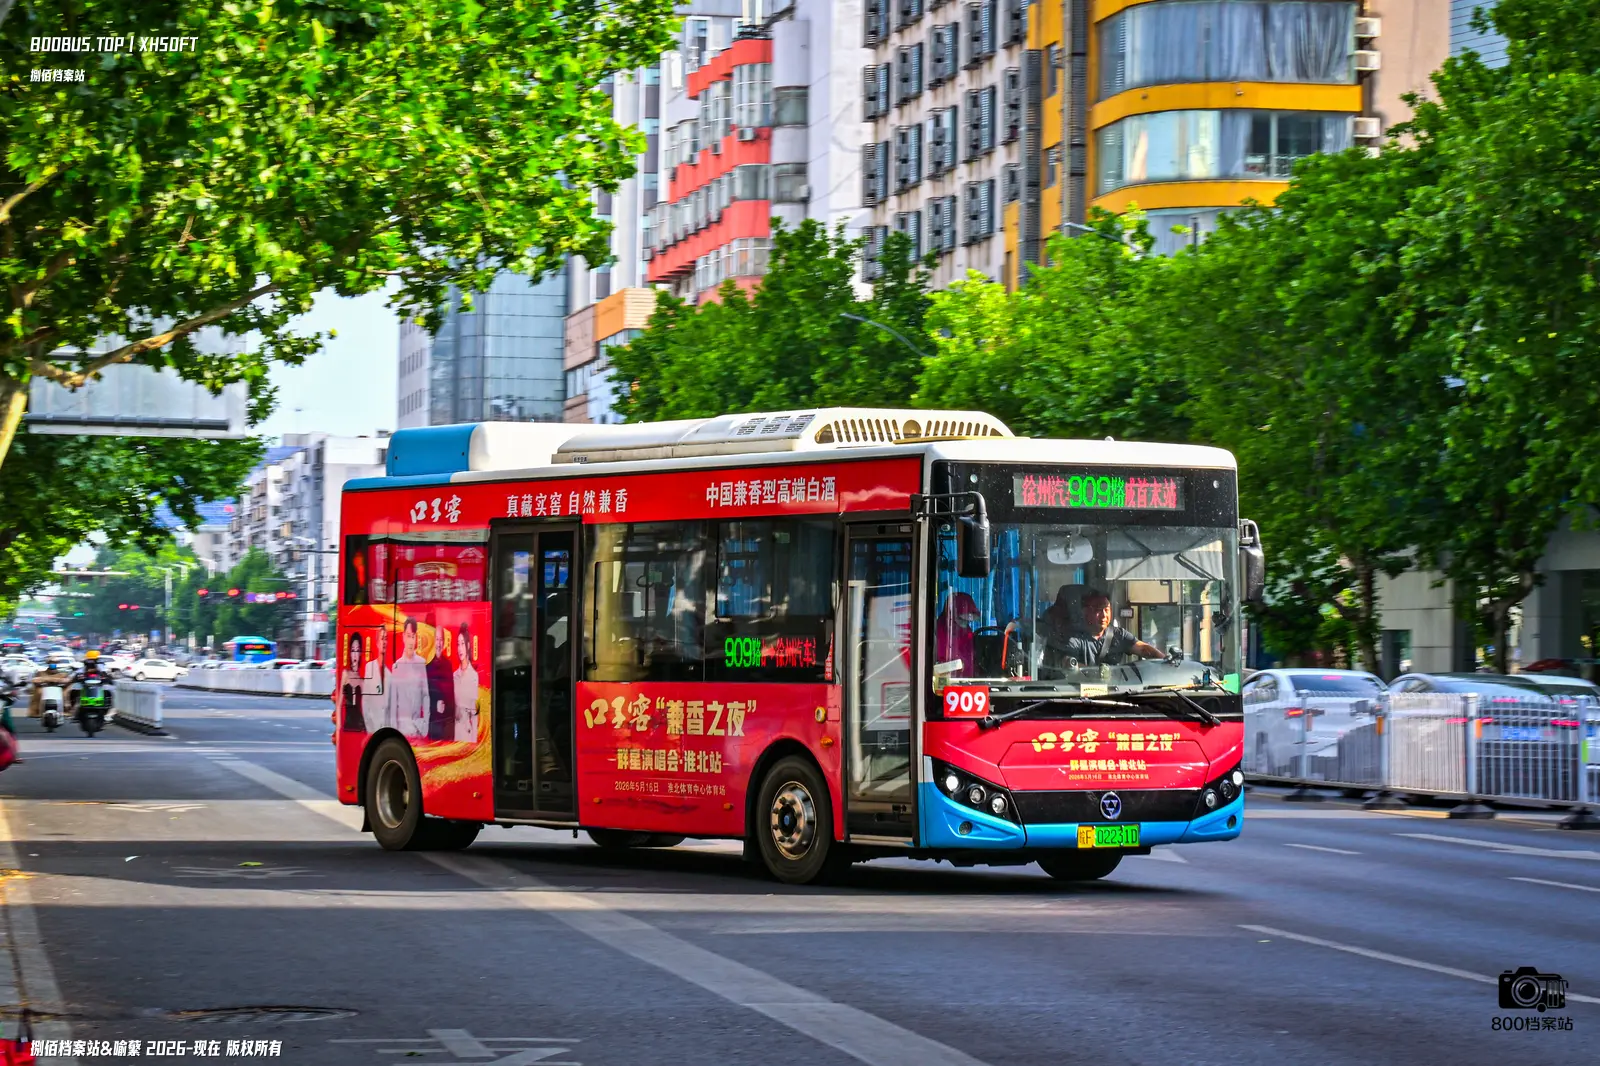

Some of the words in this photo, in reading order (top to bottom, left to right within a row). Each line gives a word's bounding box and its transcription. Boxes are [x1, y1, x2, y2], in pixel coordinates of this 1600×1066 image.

[506, 492, 562, 517] 真藏实窖
[568, 488, 628, 515] 自然兼香
[706, 476, 836, 508] 中国兼香型高端白酒
[410, 494, 462, 524] 口子窖
[584, 693, 651, 732] 口子窖
[946, 691, 986, 712] 909
[1031, 728, 1100, 753] 口子窖
